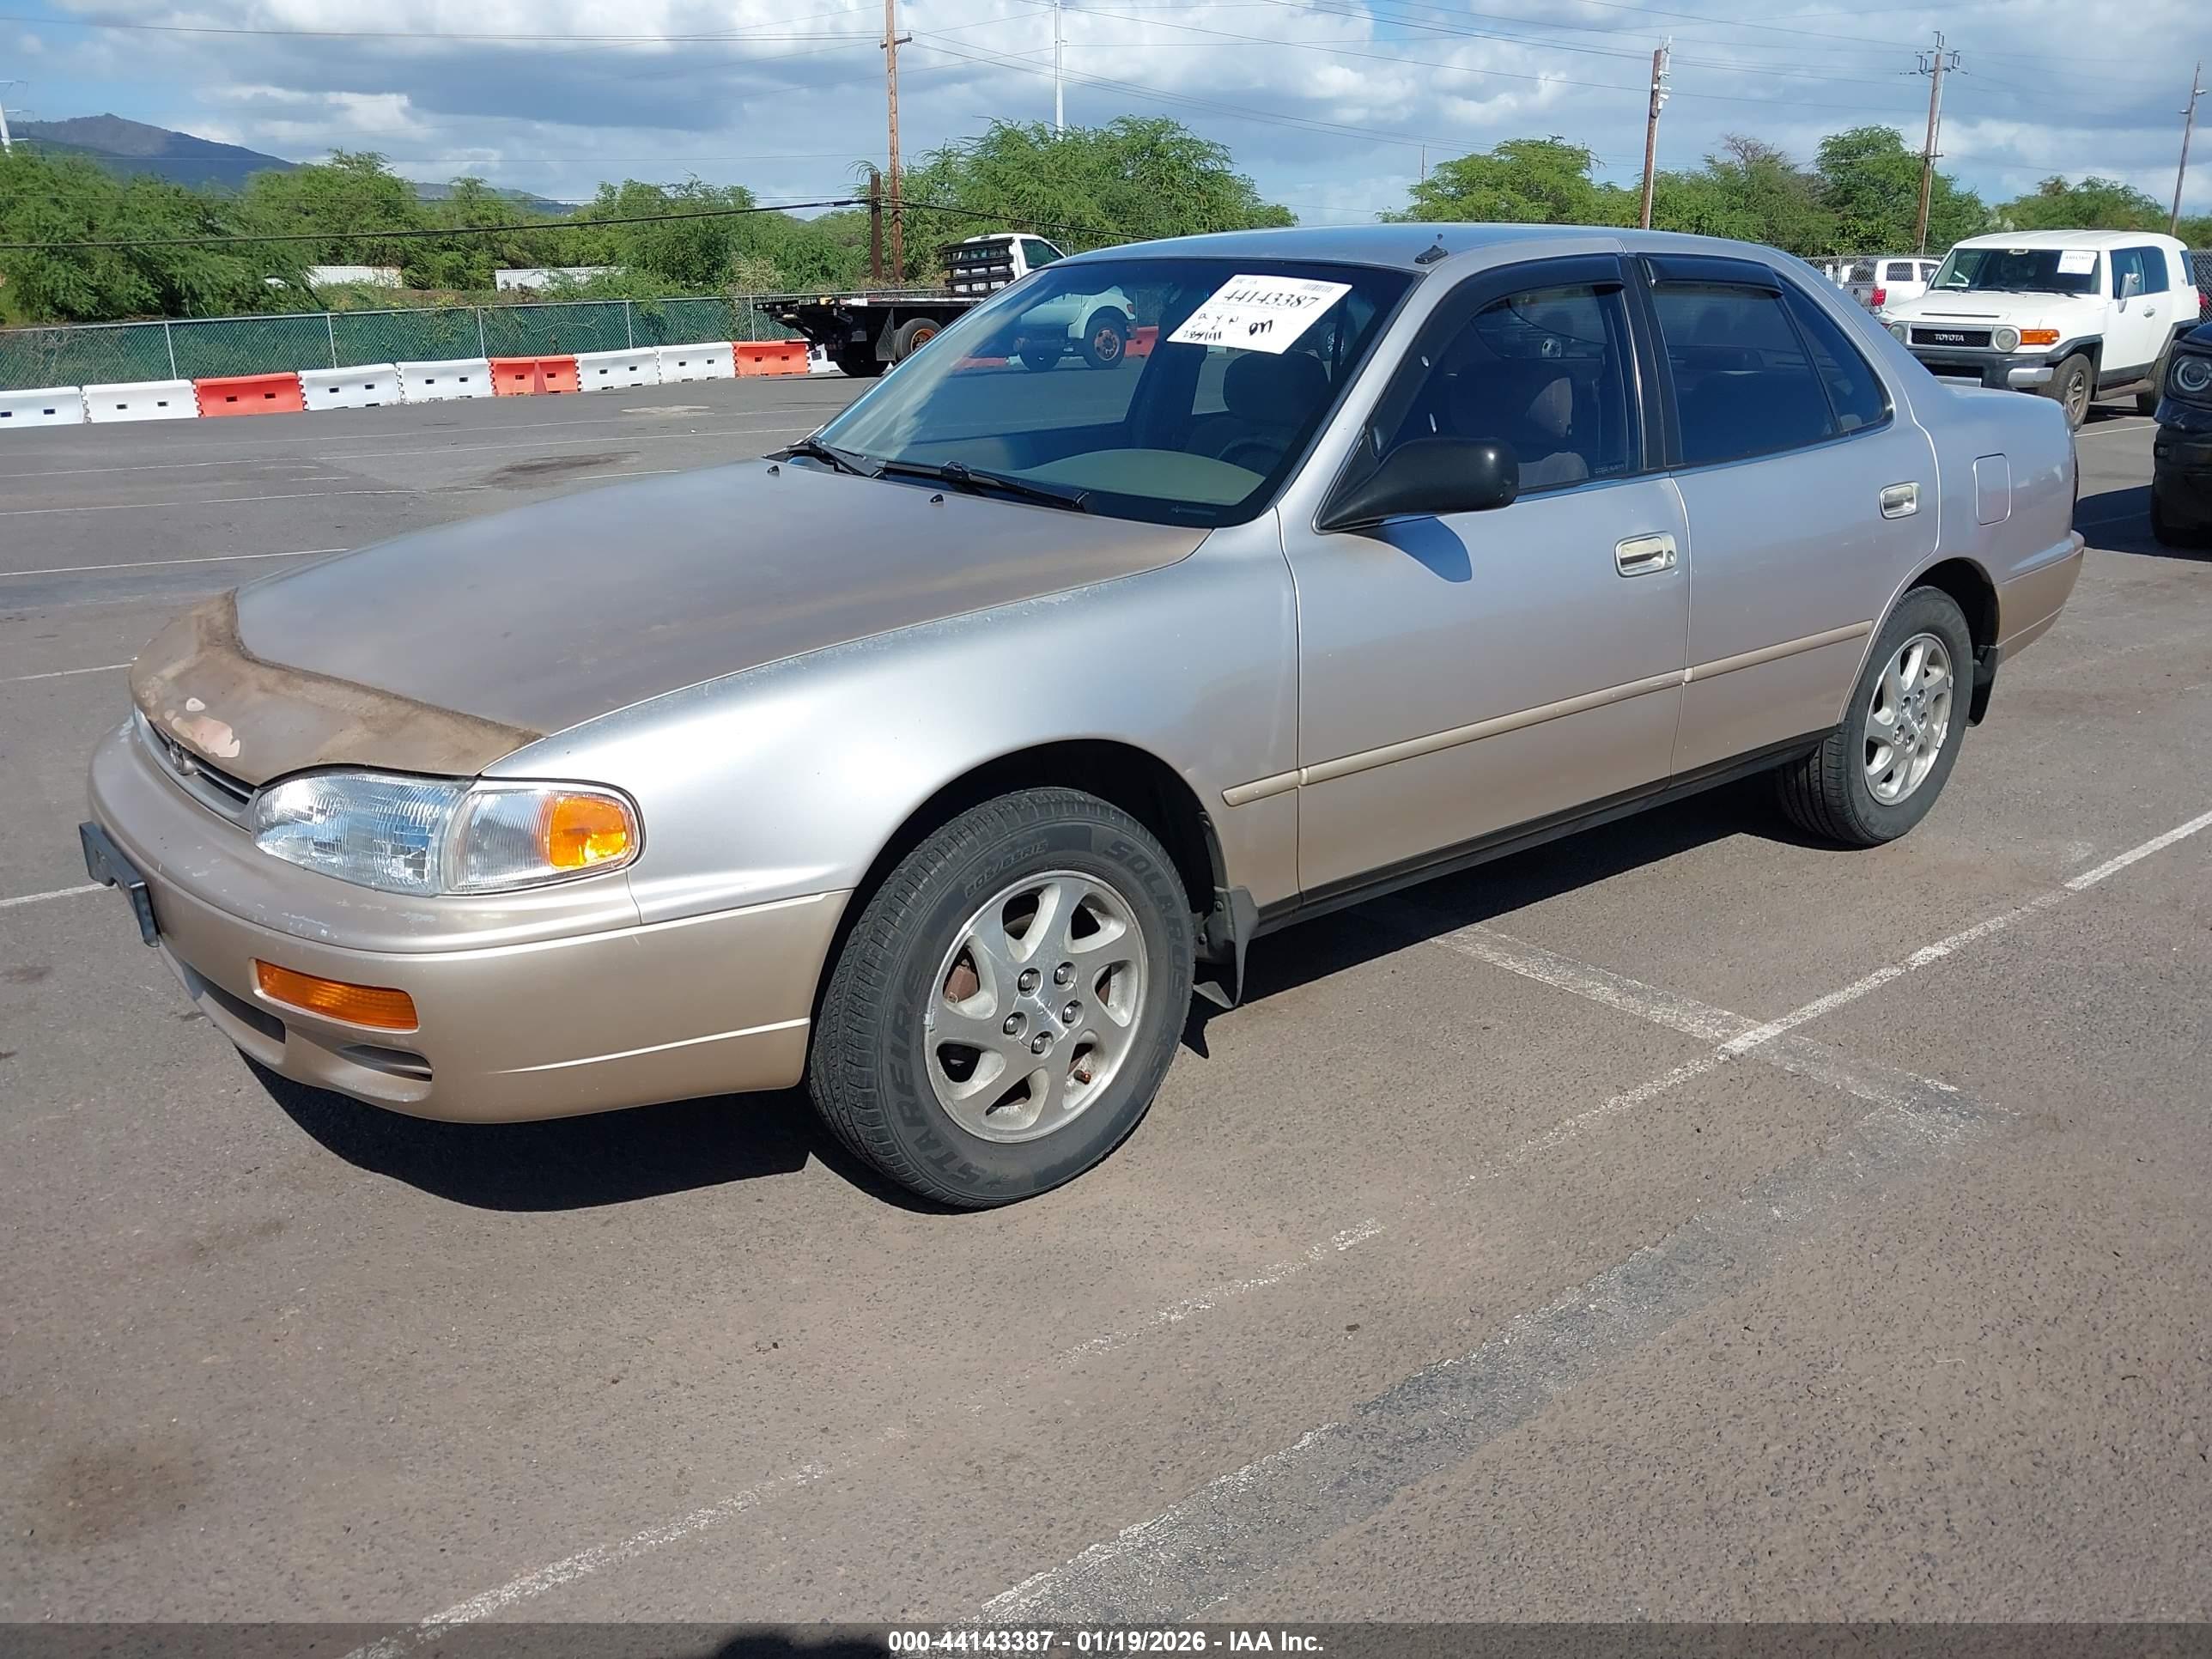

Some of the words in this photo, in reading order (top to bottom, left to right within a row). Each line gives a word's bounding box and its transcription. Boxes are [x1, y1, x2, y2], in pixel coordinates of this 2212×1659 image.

[1224, 289, 1320, 309] 44143387
[1934, 333, 1964, 342] TOYOTA
[888, 967, 987, 1186] STARFIRE
